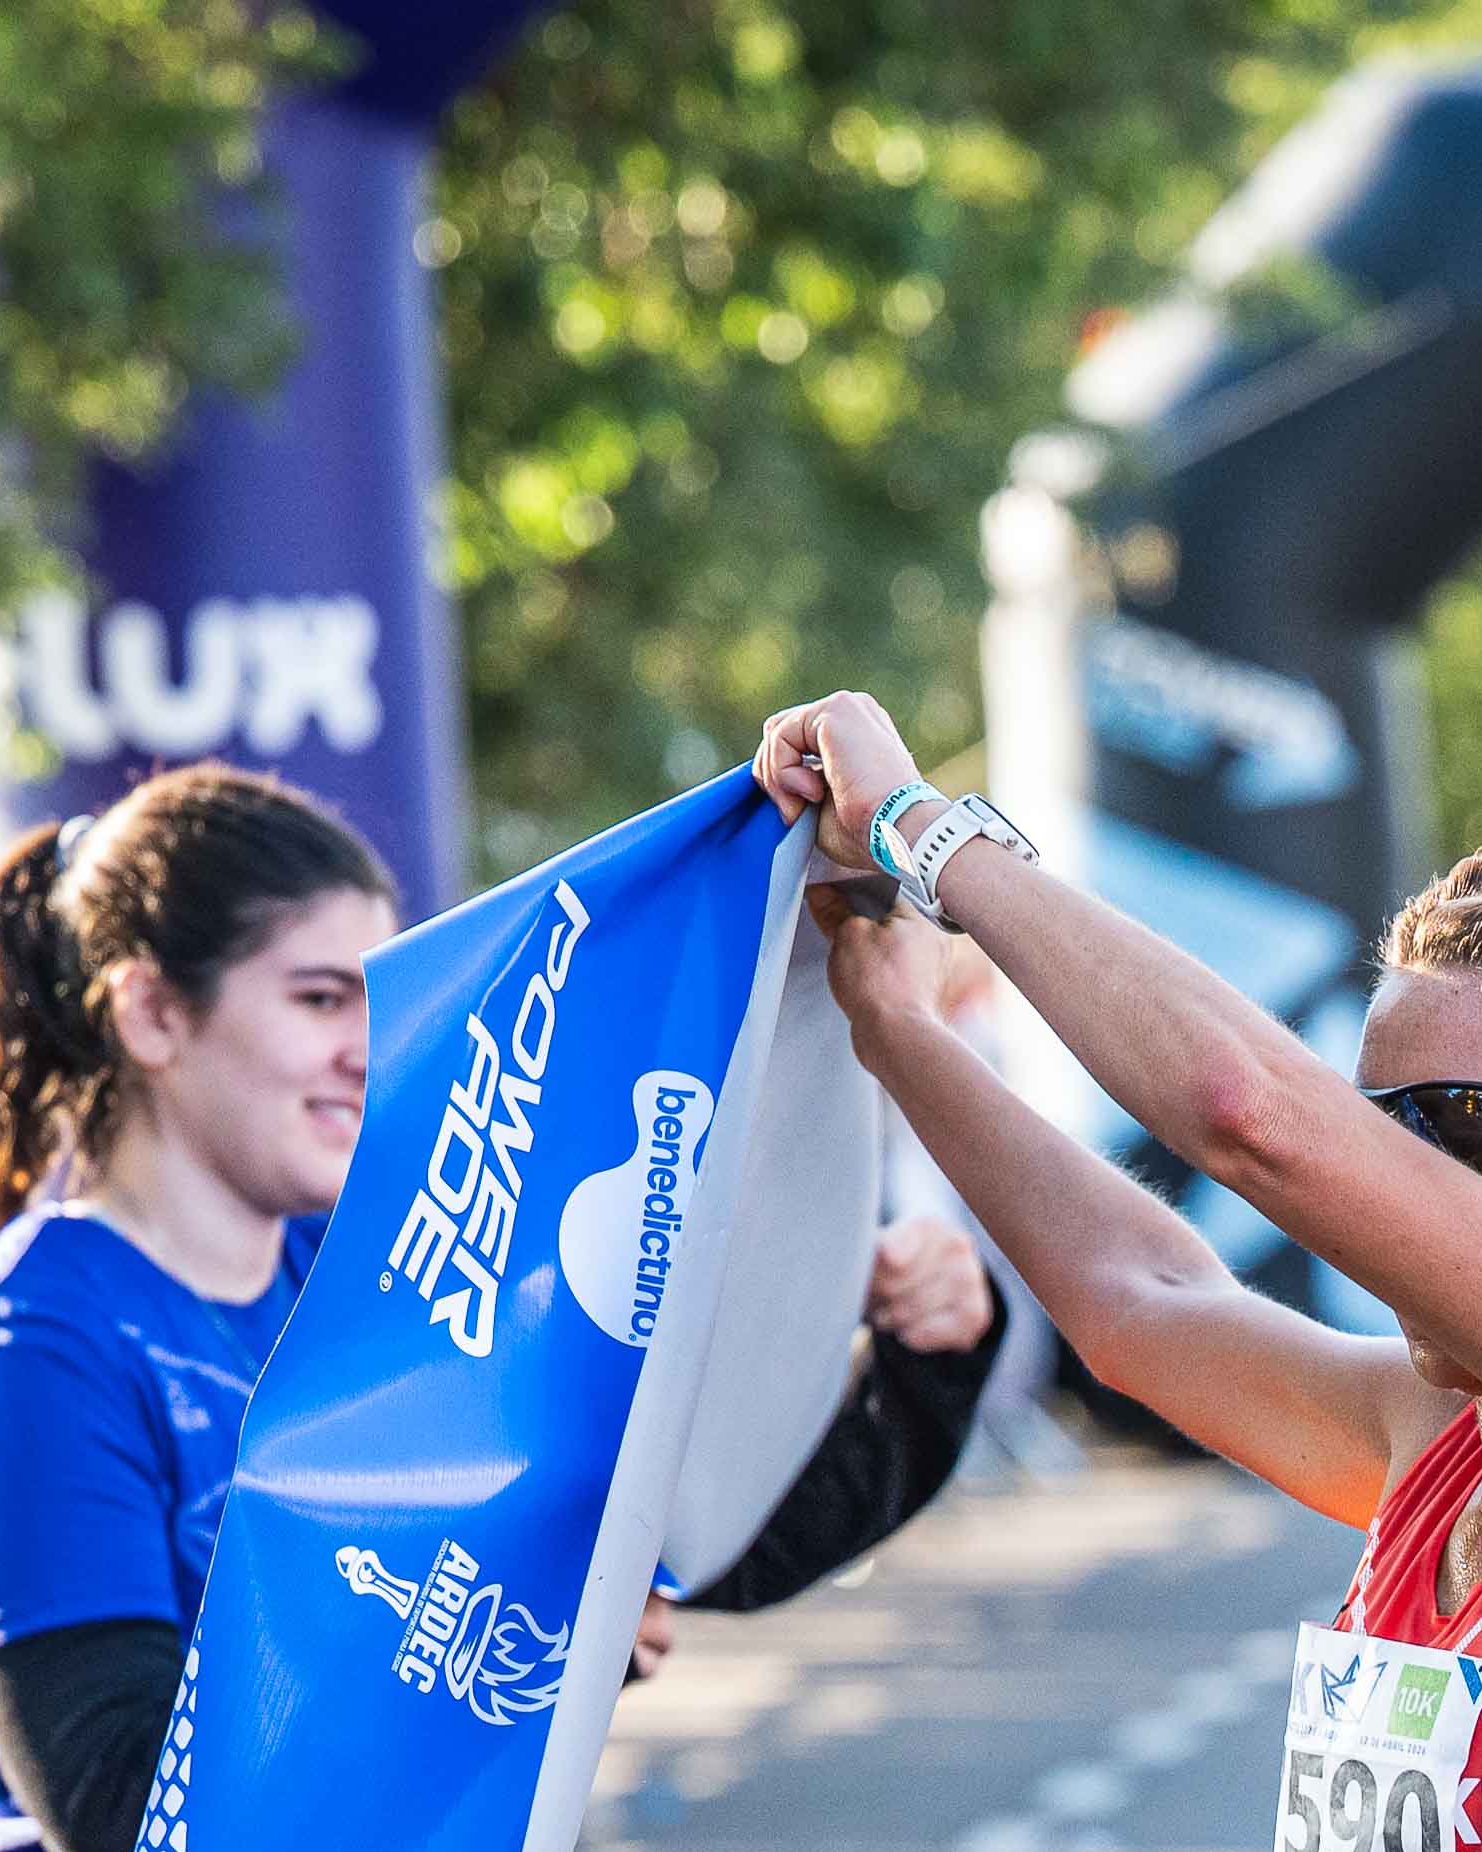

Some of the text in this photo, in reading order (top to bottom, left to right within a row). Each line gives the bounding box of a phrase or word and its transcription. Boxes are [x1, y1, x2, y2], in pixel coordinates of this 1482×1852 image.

[13, 590, 386, 762] LUX
[387, 1011, 500, 1301] ADE
[429, 878, 591, 1358] POWER
[631, 1086, 696, 1338] benedictino
[398, 1540, 480, 1694] ARDEC
[1398, 1686, 1439, 1718] 10K
